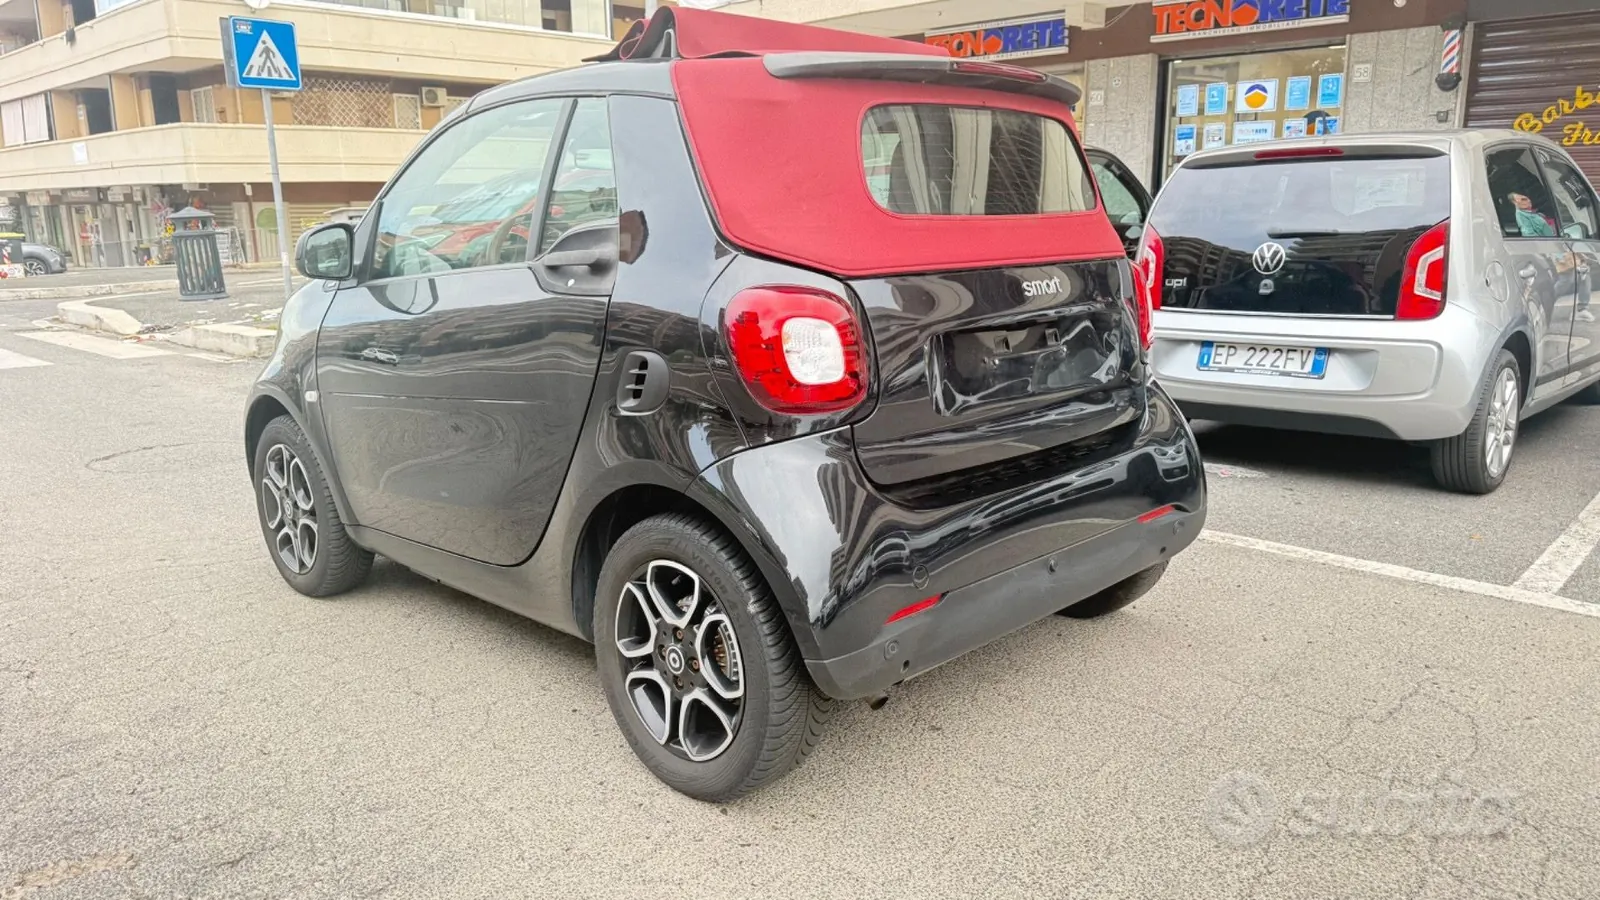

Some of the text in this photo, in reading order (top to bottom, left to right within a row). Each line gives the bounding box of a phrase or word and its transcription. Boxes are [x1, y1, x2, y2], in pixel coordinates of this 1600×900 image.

[1152, 0, 1349, 35] TECNORETE
[1354, 66, 1369, 78] 58
[1021, 275, 1063, 297] smart
[1165, 276, 1188, 289] up!
[1212, 344, 1312, 371] EP 222FV
